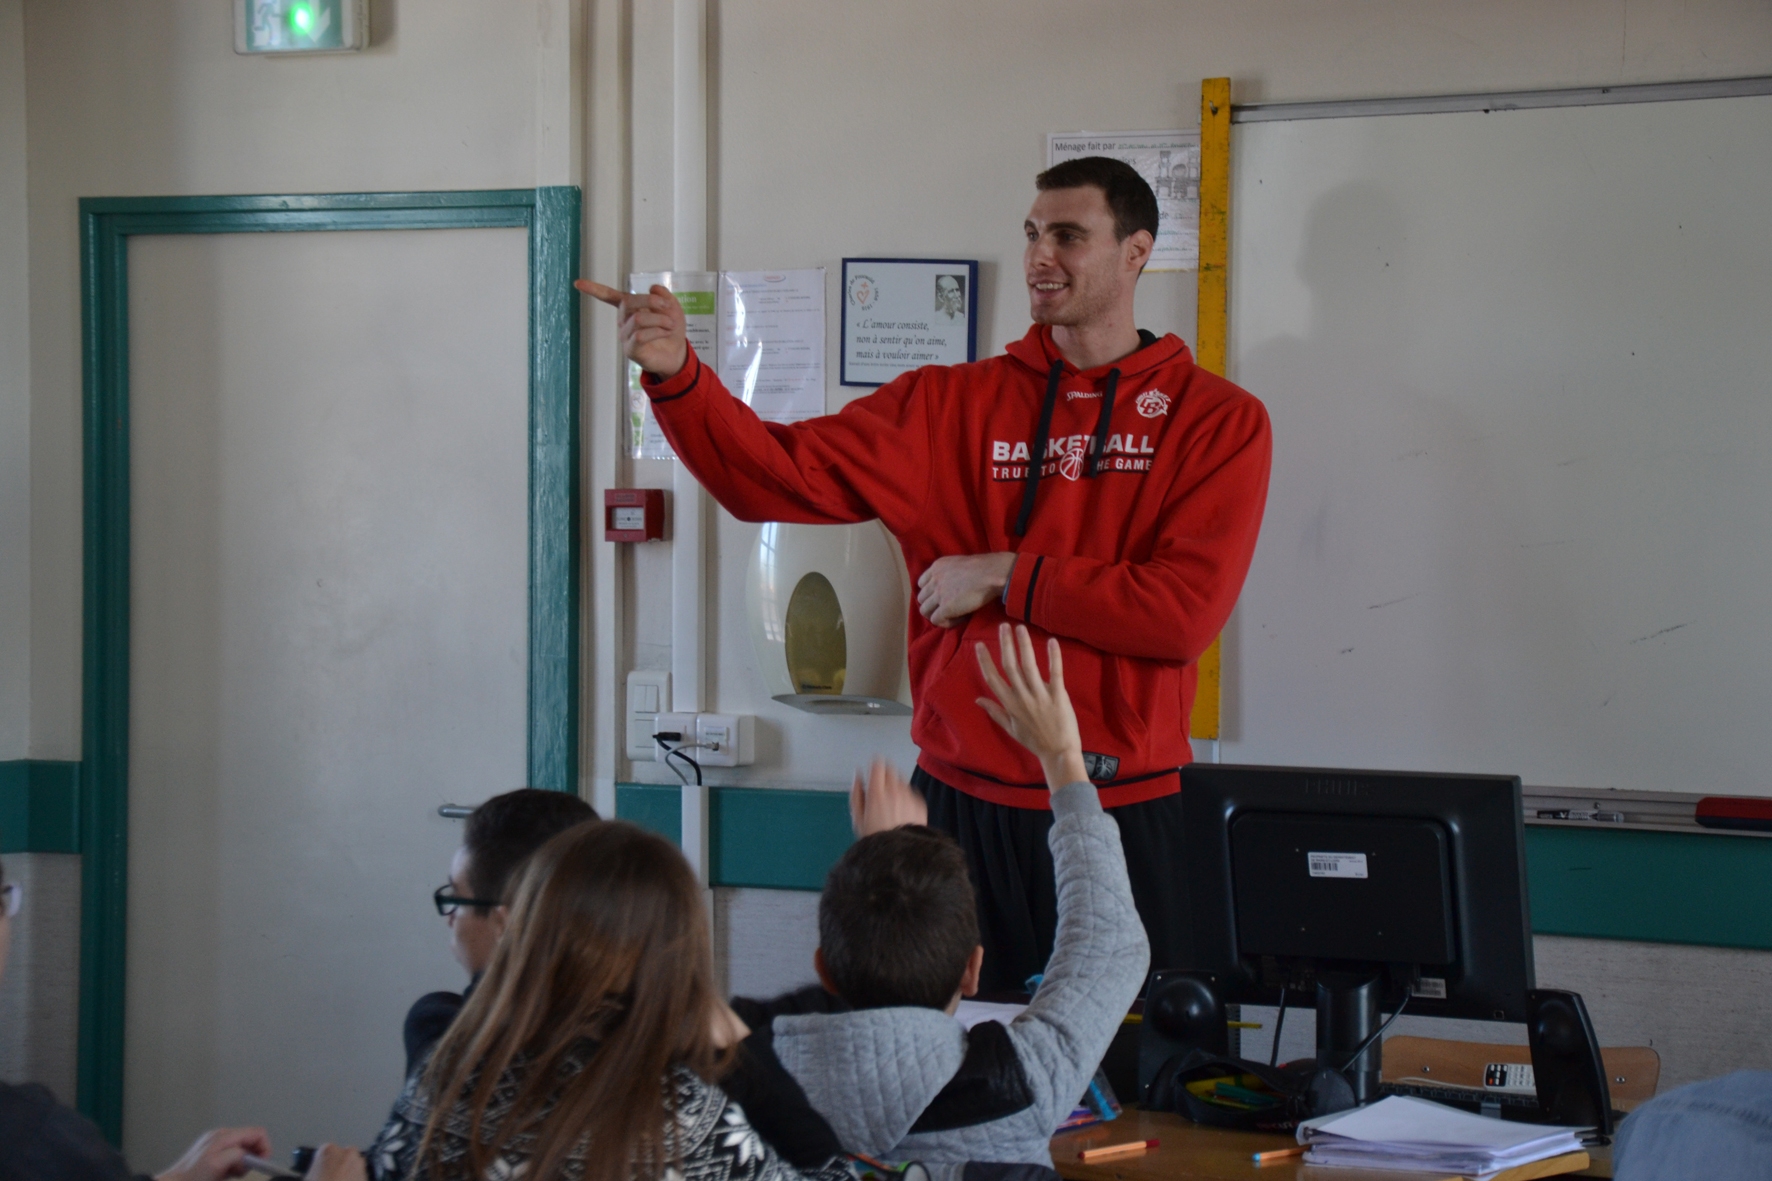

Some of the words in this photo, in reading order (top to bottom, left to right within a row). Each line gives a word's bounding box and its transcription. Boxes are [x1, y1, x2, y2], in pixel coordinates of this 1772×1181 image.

[1055, 142, 1086, 152] Ménage
[1088, 141, 1101, 150] fait
[1103, 143, 1116, 151] par
[862, 318, 897, 329] L'amour
[897, 320, 930, 332] consiste,
[856, 336, 871, 344] non
[872, 334, 878, 344] à
[879, 334, 902, 344] sentir
[903, 334, 925, 348] qu'on
[926, 335, 947, 347] aime,
[856, 348, 874, 359] mais
[875, 349, 881, 359] à
[882, 348, 911, 360] vouloir
[911, 350, 934, 361] aimer
[1066, 391, 1103, 401] SPALDING
[992, 433, 1154, 461] BAKETALL
[1096, 459, 1110, 471] HE
[1115, 457, 1153, 471] GAME
